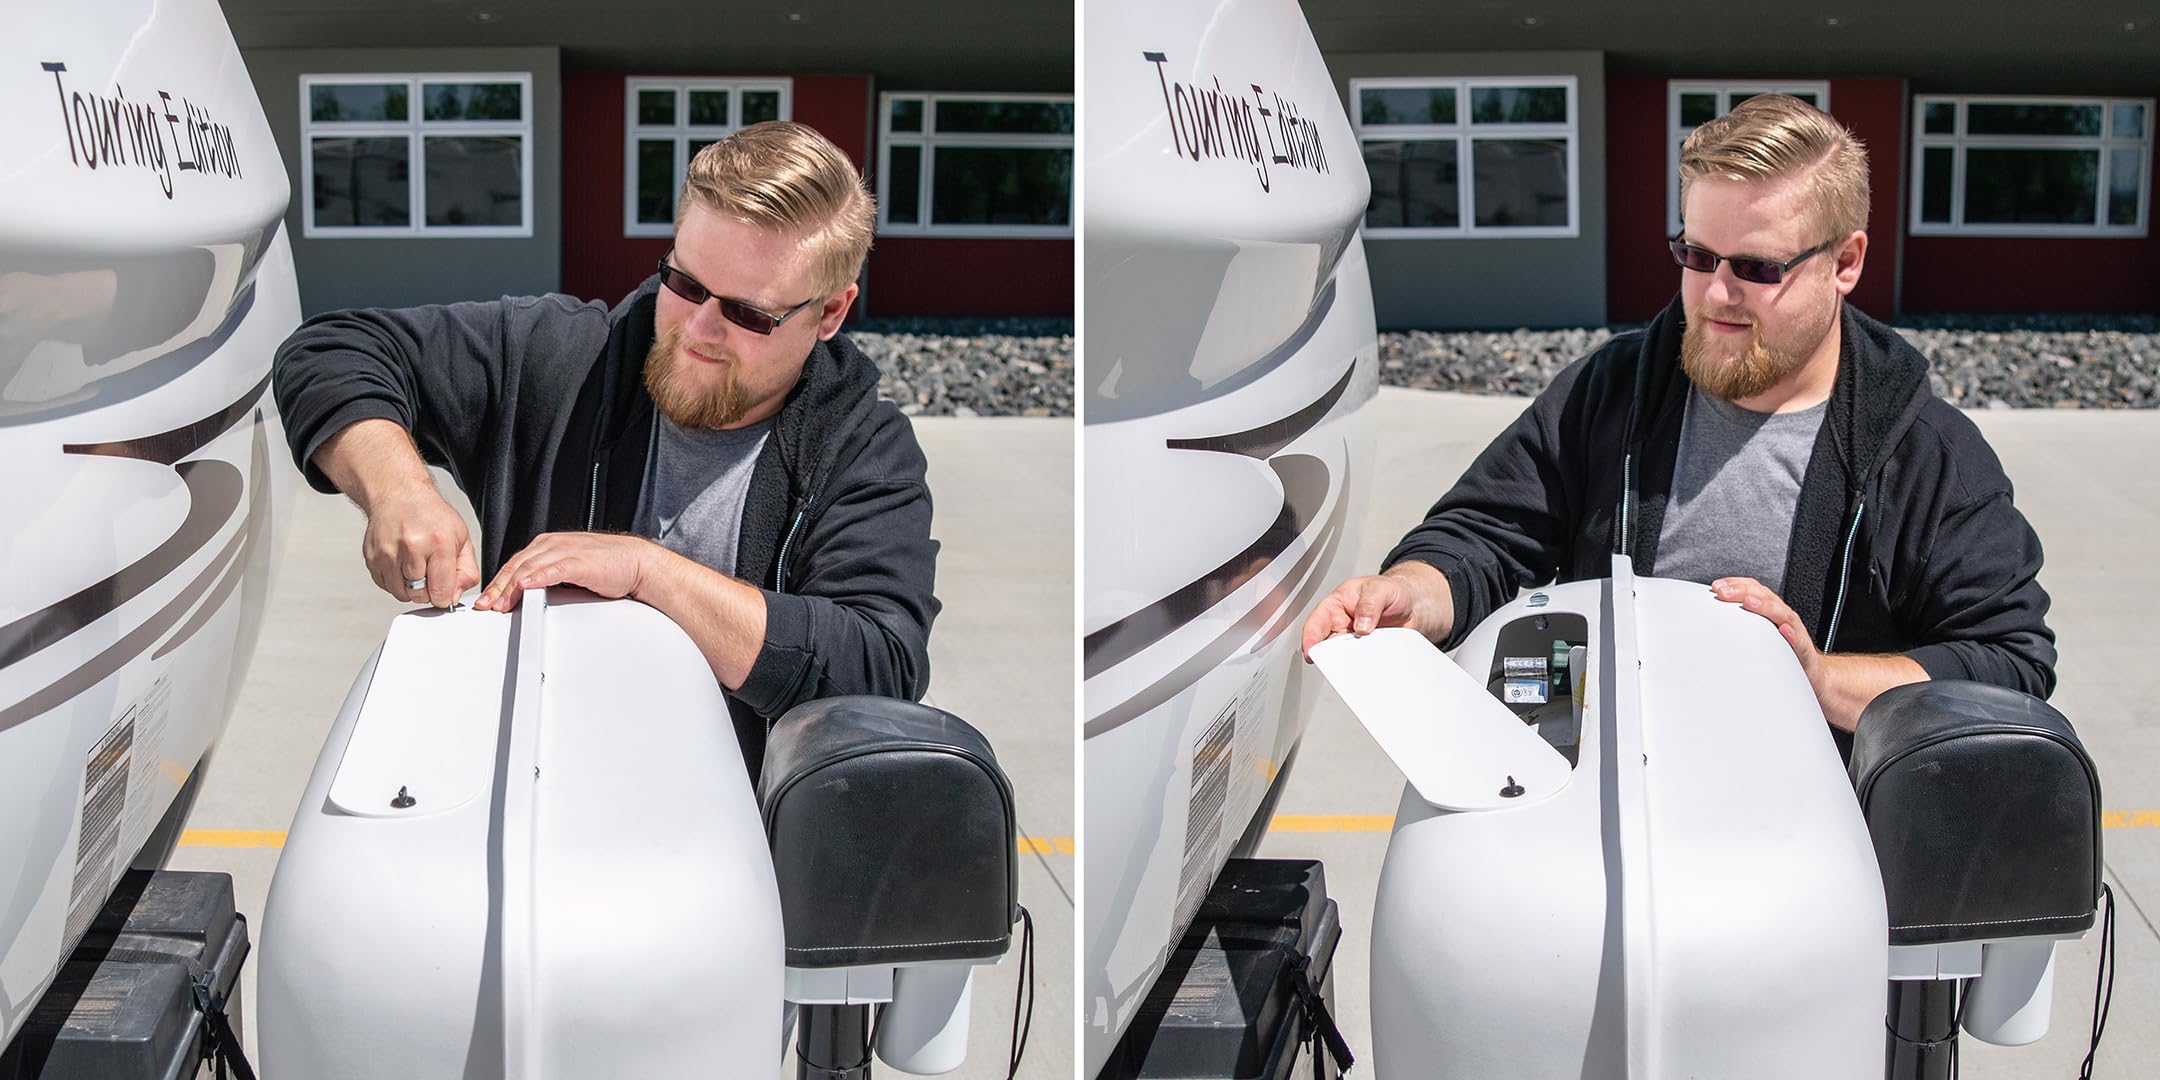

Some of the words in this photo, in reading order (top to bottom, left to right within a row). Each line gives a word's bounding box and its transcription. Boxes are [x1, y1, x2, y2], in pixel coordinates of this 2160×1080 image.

[40, 61, 173, 200] Touring
[157, 90, 242, 180] Edition
[1142, 51, 1270, 194] Touring
[1250, 83, 1330, 176] Edition
